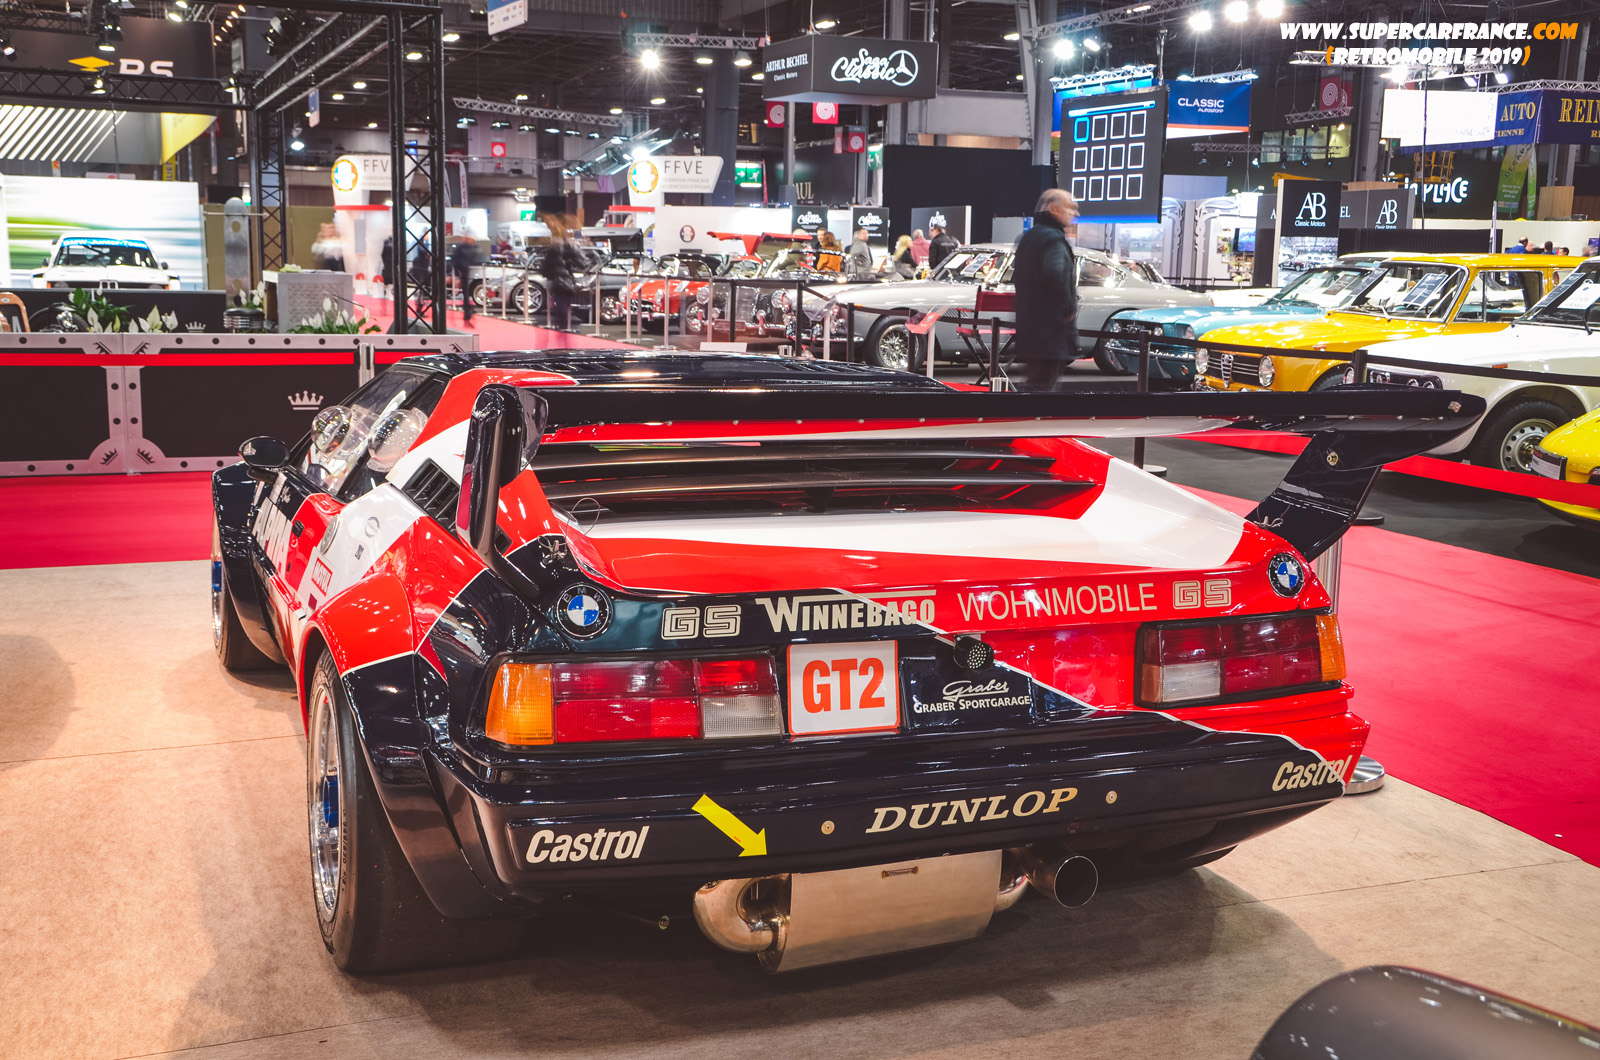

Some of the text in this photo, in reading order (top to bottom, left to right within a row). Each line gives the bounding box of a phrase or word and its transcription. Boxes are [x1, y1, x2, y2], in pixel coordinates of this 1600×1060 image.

[766, 53, 808, 72] ARTHUR BECHTEL
[859, 48, 888, 66] Saga
[831, 57, 898, 83] Classic
[1178, 98, 1224, 108] CLASSIC
[1500, 102, 1536, 122] AUTO
[1496, 128, 1525, 138] IENNE
[364, 160, 391, 172] FFV
[664, 160, 703, 174] FFVE
[1423, 177, 1469, 203] PLACE
[1296, 192, 1326, 220] AB
[1376, 200, 1398, 225] AB
[562, 587, 602, 603] BMW
[662, 578, 1232, 640] GS WINNEBAGO WOHNMOBILE GS
[802, 657, 885, 714] GT2
[942, 679, 1009, 702] Graber
[913, 696, 1030, 714] GRABER SPORTGARAGE
[1272, 754, 1353, 792] Castrol
[526, 787, 1078, 864] Castrol DUNLOP
